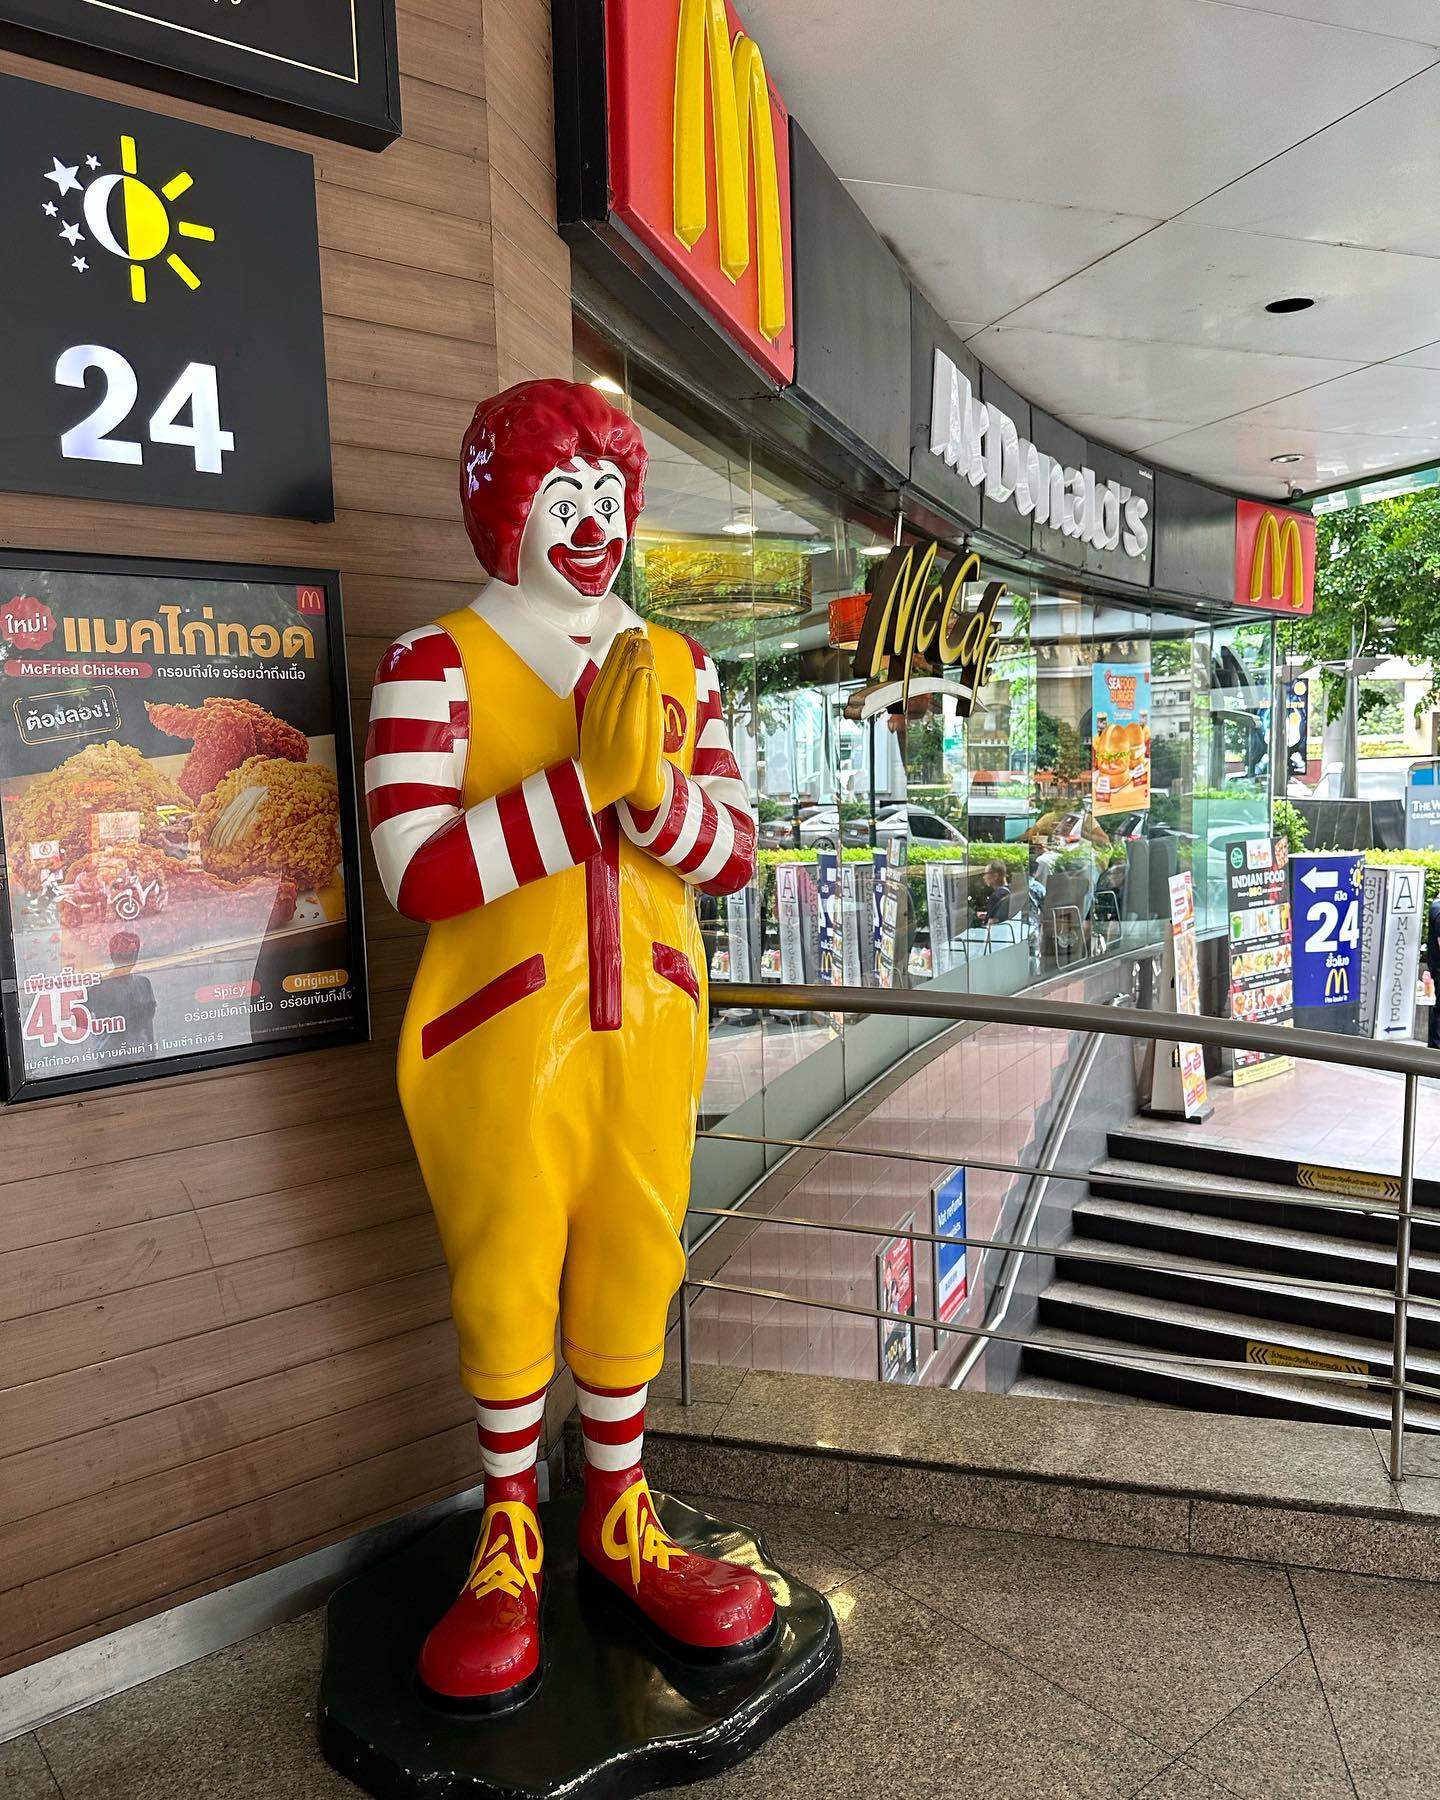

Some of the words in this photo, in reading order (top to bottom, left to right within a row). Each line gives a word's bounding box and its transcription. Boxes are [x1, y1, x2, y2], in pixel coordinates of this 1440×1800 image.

[54, 344, 235, 475] 24
[929, 347, 1149, 557] McDonald's
[5, 612, 48, 634] ใหม่!
[63, 604, 316, 659] แมคไก่ทอด
[20, 663, 79, 675] McFried
[82, 664, 139, 676] Chicken
[157, 663, 220, 678] กรอบถึงใจ
[26, 699, 111, 731] ต้องลอง!
[1231, 872, 1263, 889] INDIAN
[1264, 869, 1285, 885] FOOD
[1394, 876, 1415, 909] A
[1305, 900, 1360, 953] 24
[294, 971, 340, 988] Original
[1390, 916, 1408, 1022] MASSAGE
[213, 984, 246, 1000] Spicy
[25, 988, 90, 1045] 45
[91, 1016, 125, 1034] บาท
[147, 1042, 160, 1052] 11
[162, 1034, 193, 1050] โมงเช้า
[195, 1032, 216, 1046] ถึงตี
[217, 1032, 224, 1041] 5
[946, 1192, 963, 1220] refund
